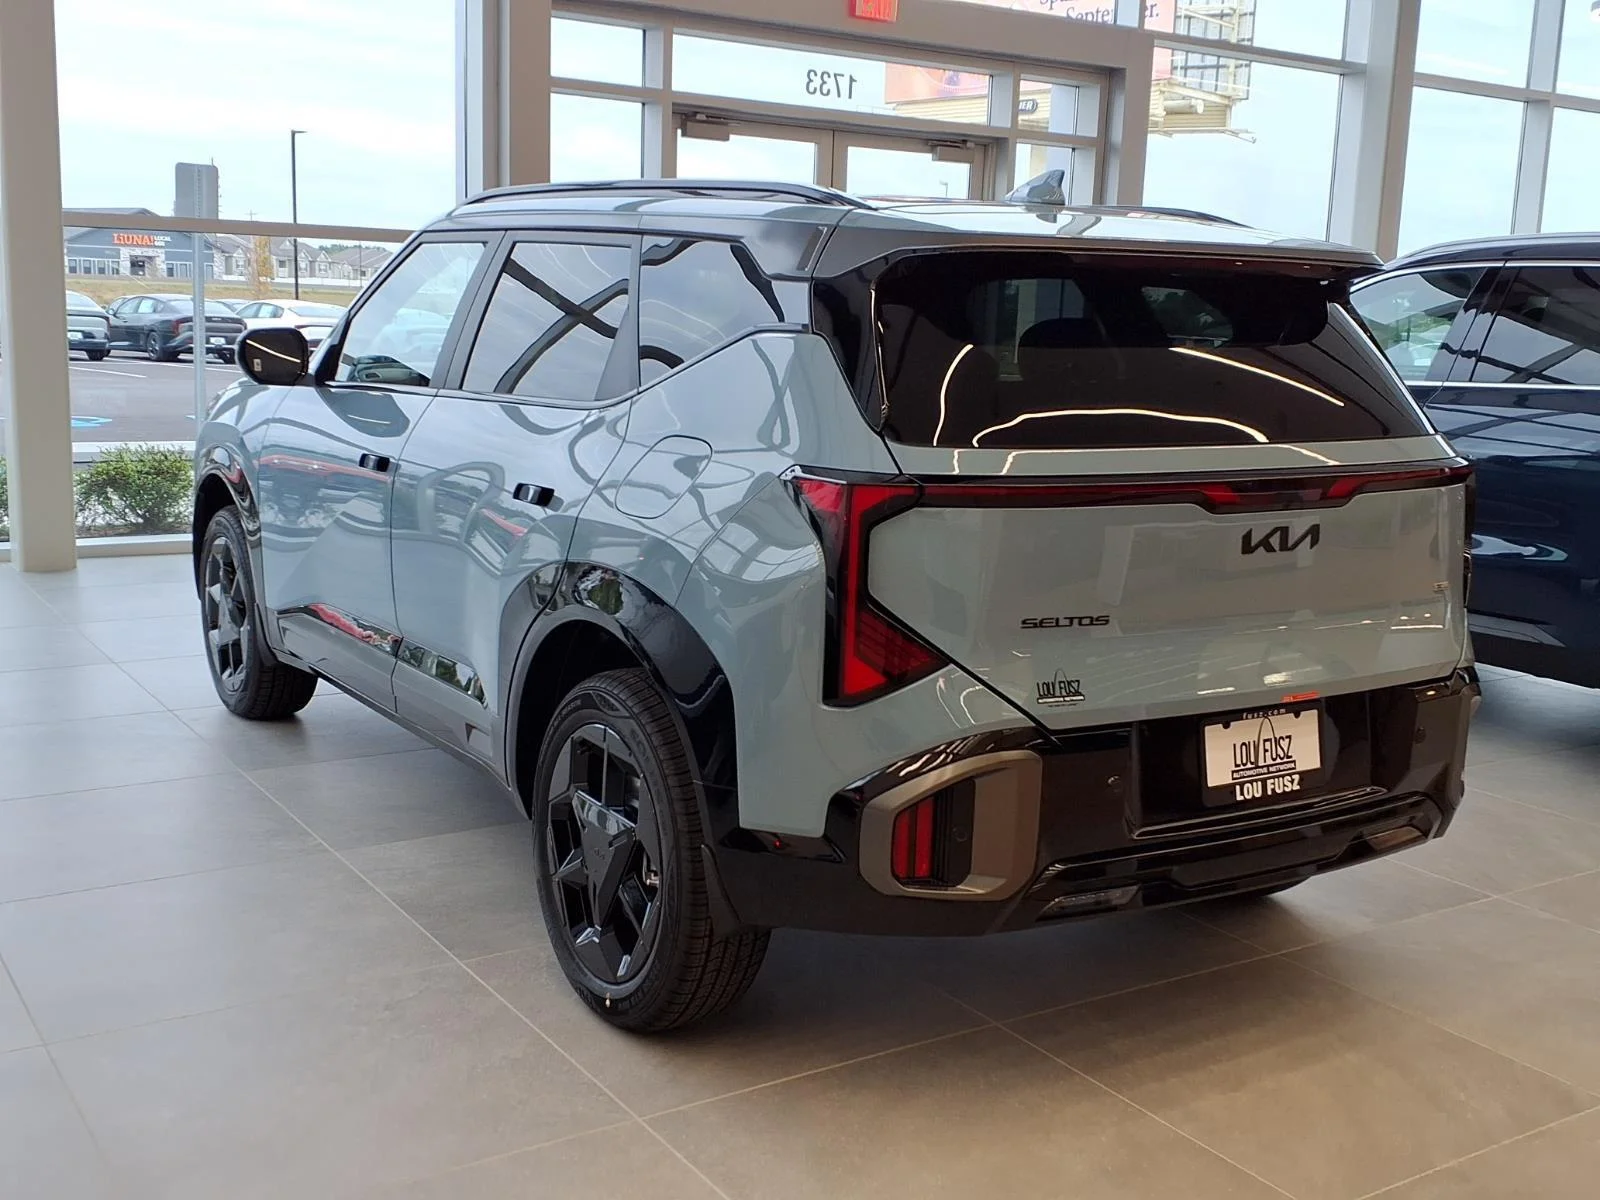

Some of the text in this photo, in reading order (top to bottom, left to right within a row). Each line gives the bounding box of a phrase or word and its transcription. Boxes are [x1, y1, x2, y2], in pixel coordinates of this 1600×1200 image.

[1241, 523, 1321, 555] KIA
[1020, 615, 1111, 630] SELTOS
[1036, 679, 1081, 697] LOU FUSZ
[1242, 707, 1287, 720] fusz.com
[1233, 734, 1294, 769] LOU FUSZ
[1232, 761, 1297, 779] AUTOMOTIVE NETWORK
[1235, 774, 1301, 801] LOU FUSZ
